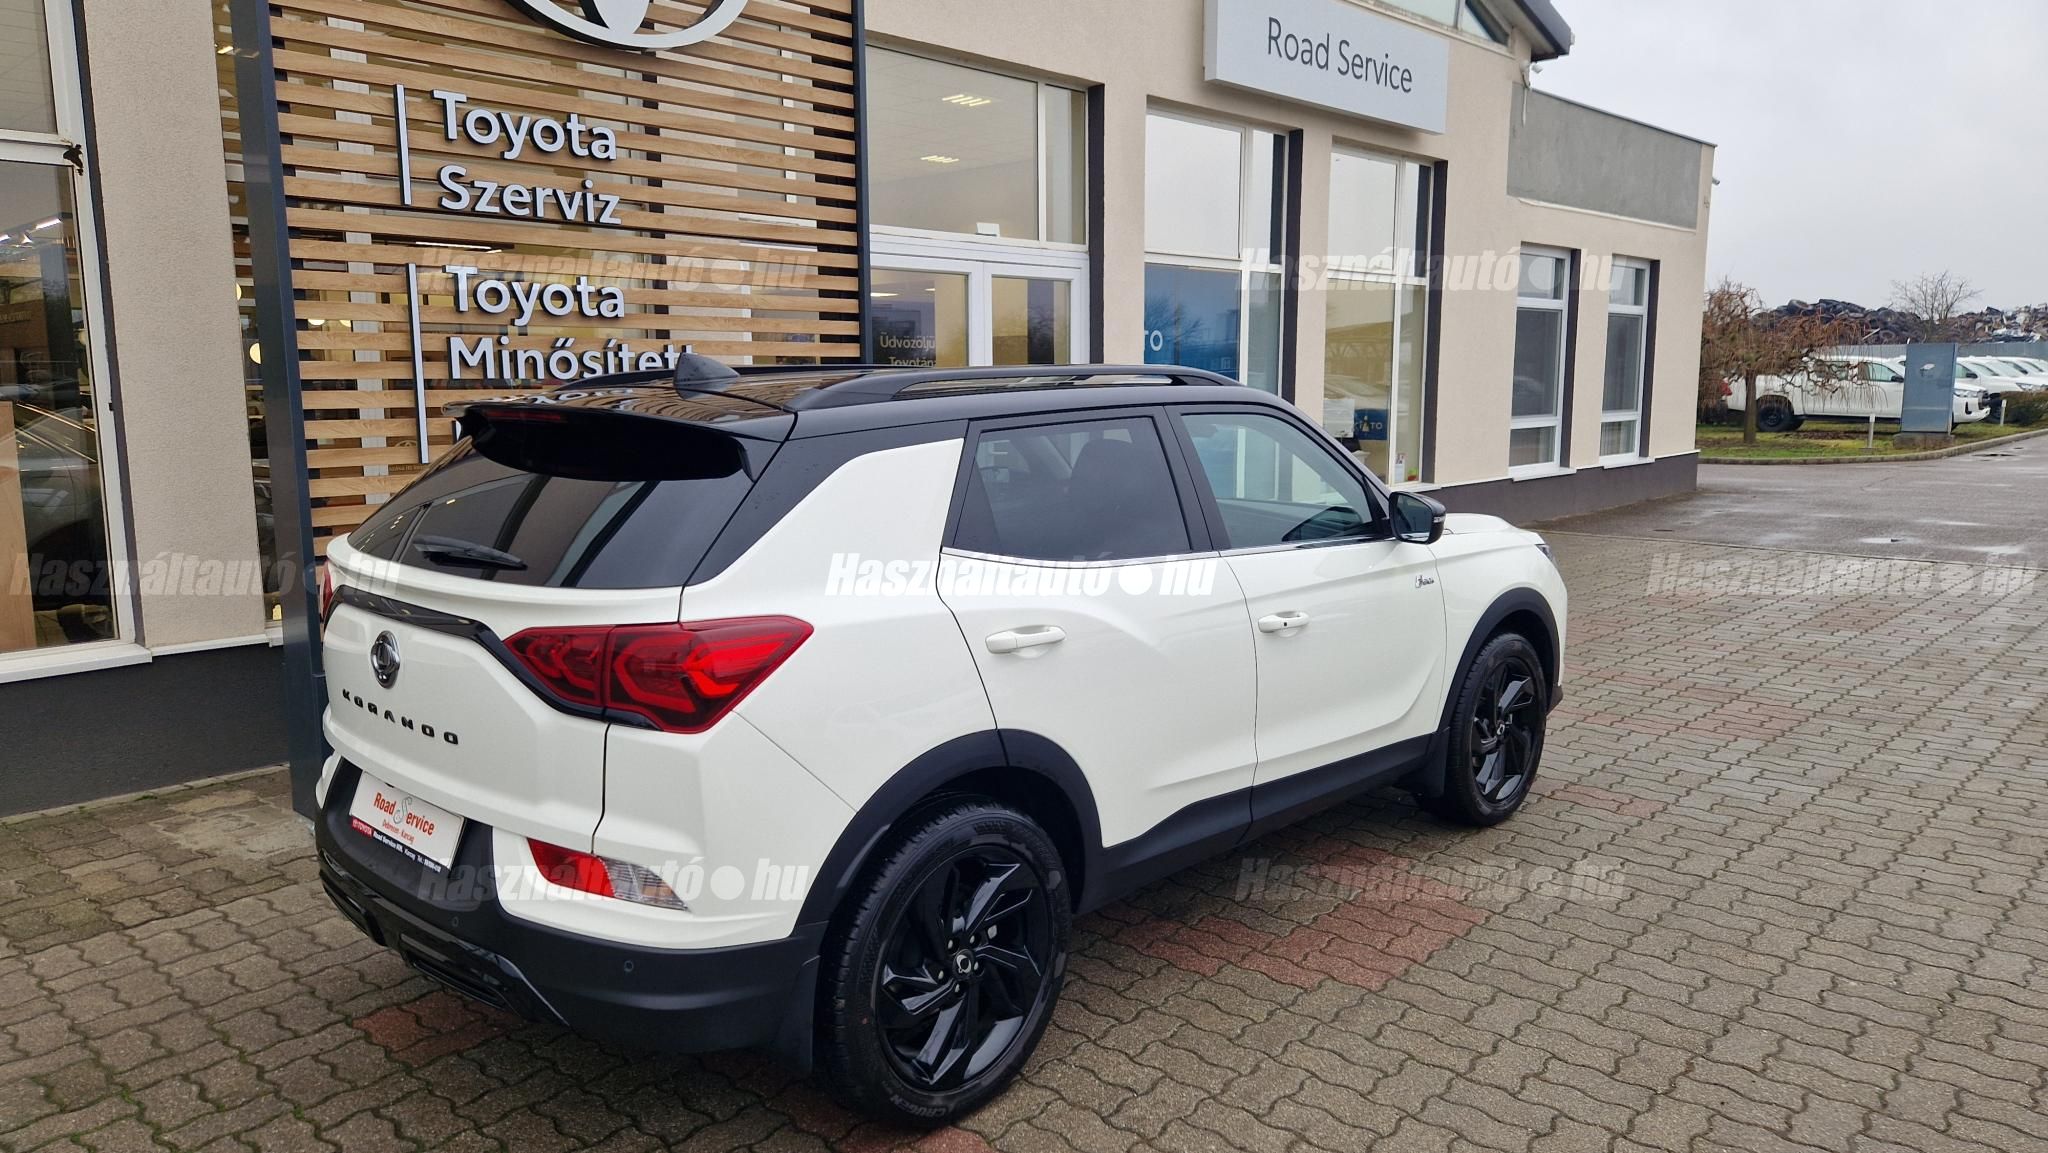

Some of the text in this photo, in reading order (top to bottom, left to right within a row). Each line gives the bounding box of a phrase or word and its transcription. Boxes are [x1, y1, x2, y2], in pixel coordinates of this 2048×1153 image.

[1268, 17, 1413, 94] Road Service
[432, 89, 617, 160] Toyota
[439, 164, 622, 225] Szerviz
[442, 265, 626, 326] Toyota
[880, 331, 936, 351] Üdvözöljü
[342, 688, 459, 745] KORANDO
[373, 792, 397, 815] Road
